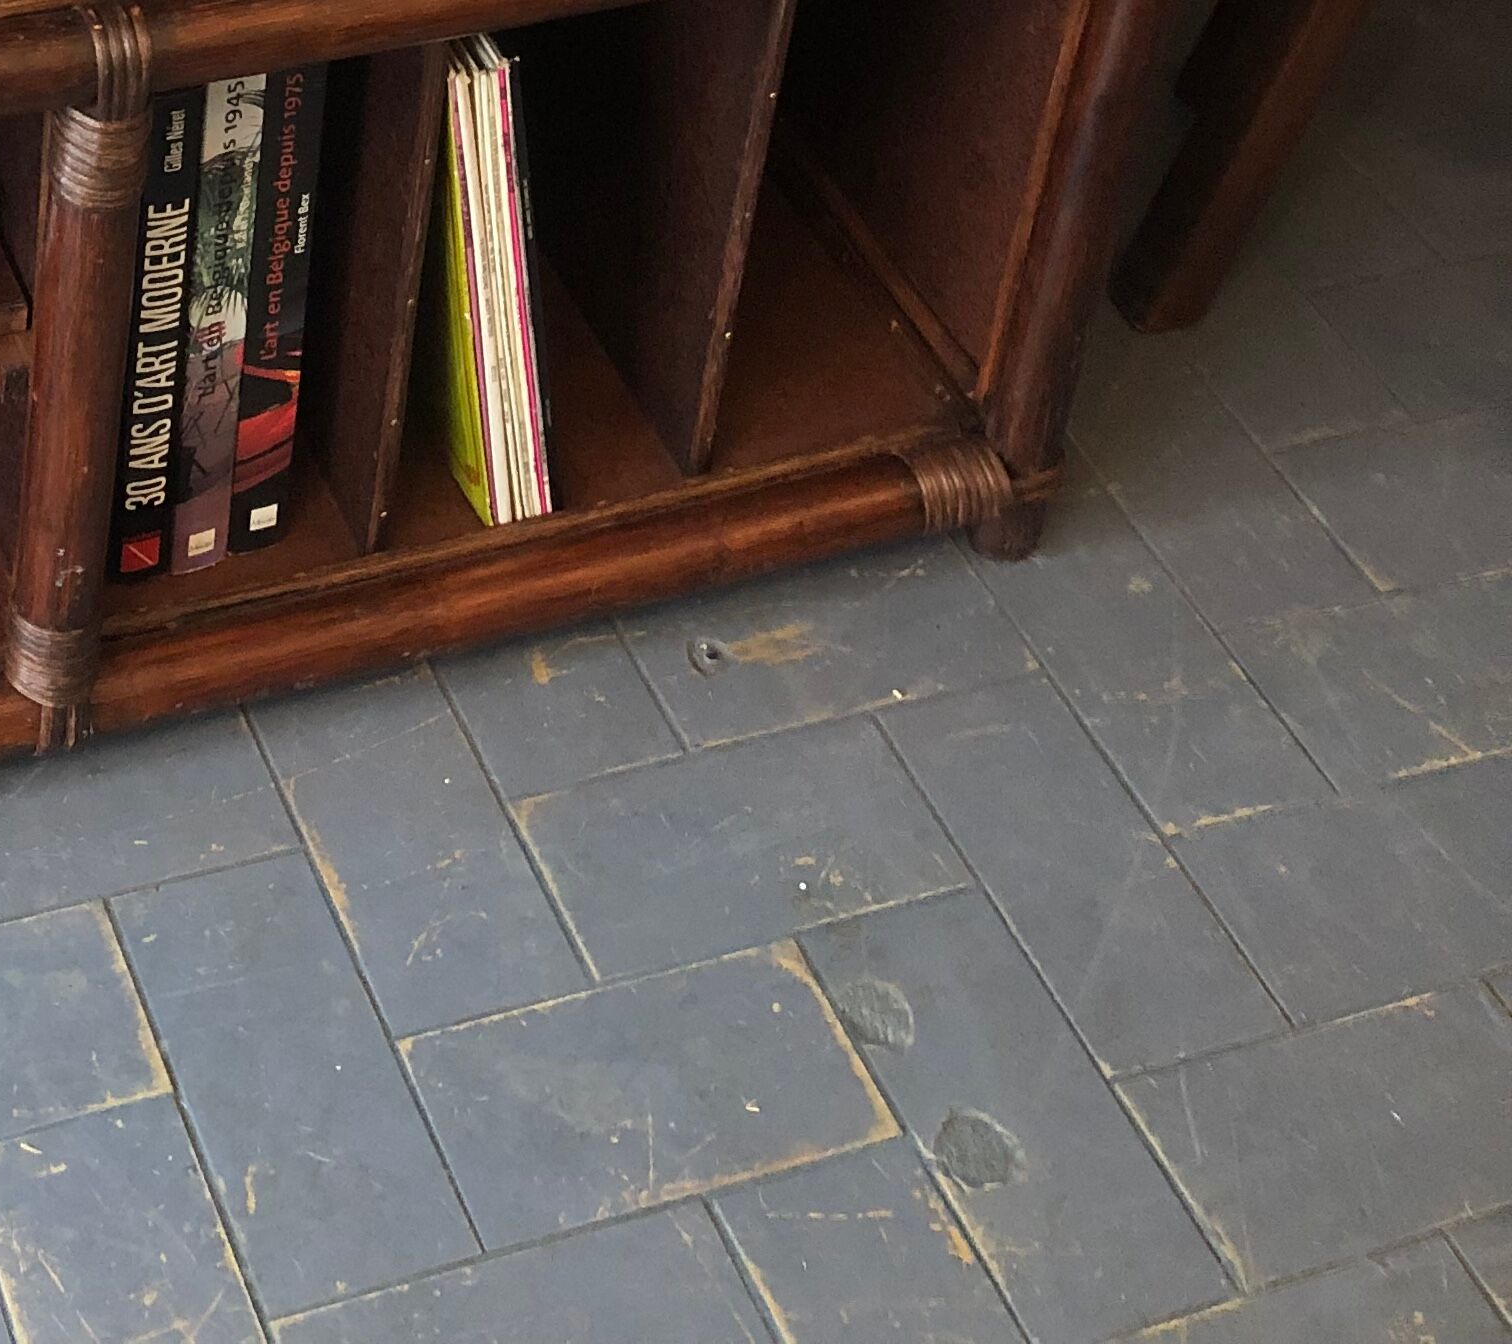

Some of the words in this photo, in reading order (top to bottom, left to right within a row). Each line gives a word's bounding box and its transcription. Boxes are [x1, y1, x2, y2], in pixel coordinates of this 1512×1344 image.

[224, 80, 245, 134] 1945
[284, 73, 304, 118] 1975
[164, 141, 184, 173] Gilles
[273, 124, 297, 192] depuis
[297, 192, 310, 214] Bex
[266, 197, 292, 285] Belgique
[294, 216, 309, 254] Florent
[139, 198, 190, 333] MODERNE
[268, 287, 284, 314] en
[132, 340, 179, 415] D'ART
[128, 418, 172, 468] ANS
[125, 475, 167, 510] 30
